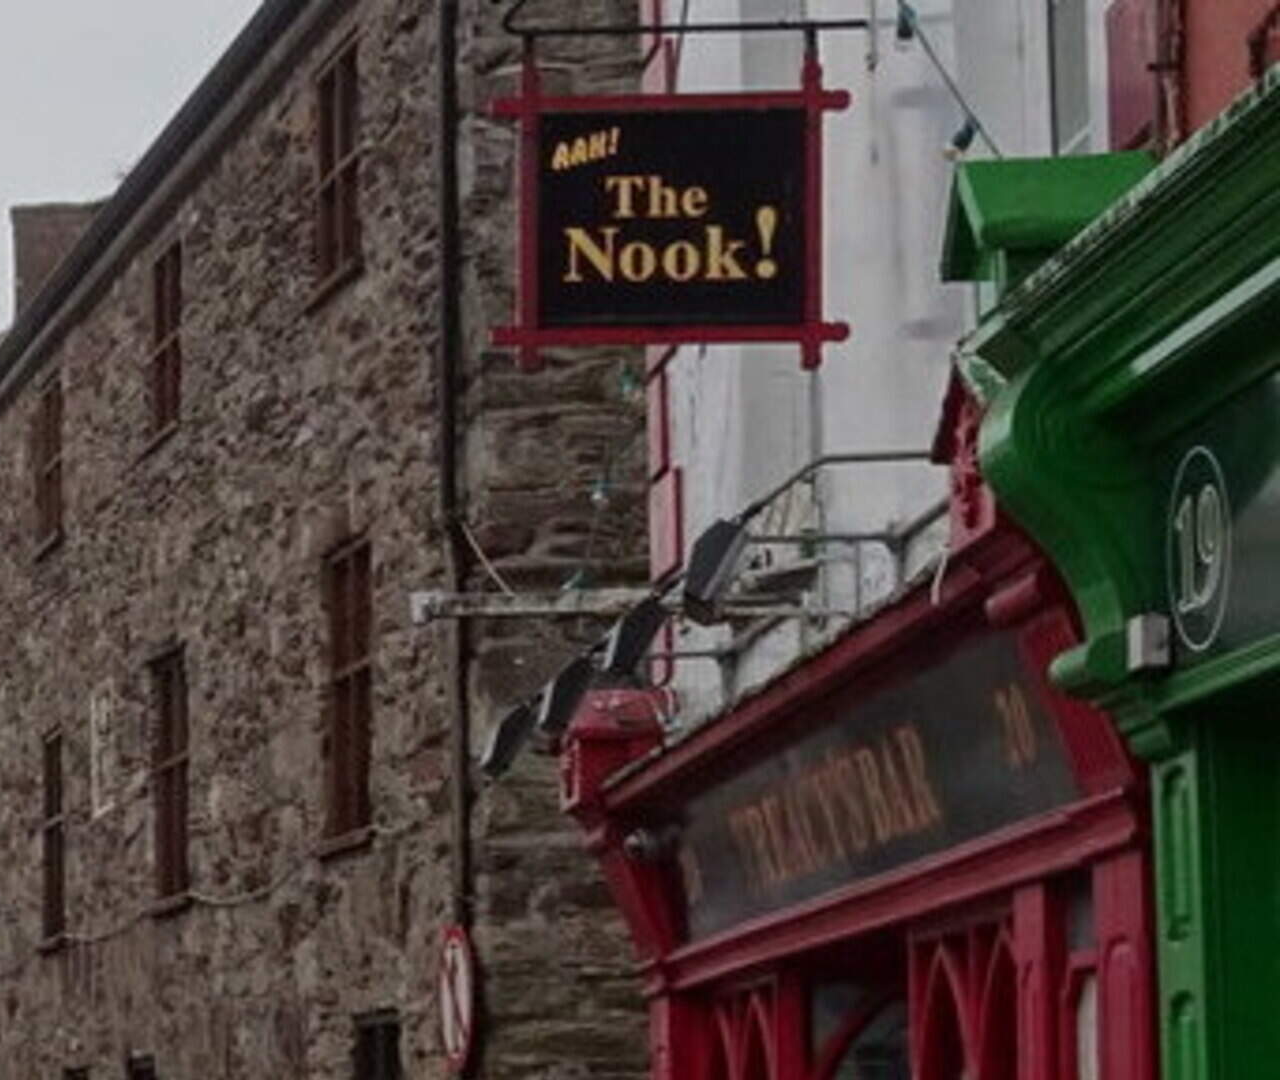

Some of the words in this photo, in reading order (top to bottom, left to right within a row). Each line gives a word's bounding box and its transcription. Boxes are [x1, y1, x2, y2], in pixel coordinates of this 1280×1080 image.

[551, 126, 621, 171] AAH!
[604, 174, 710, 220] The
[561, 204, 778, 284] Nook!
[1173, 483, 1223, 614] 19
